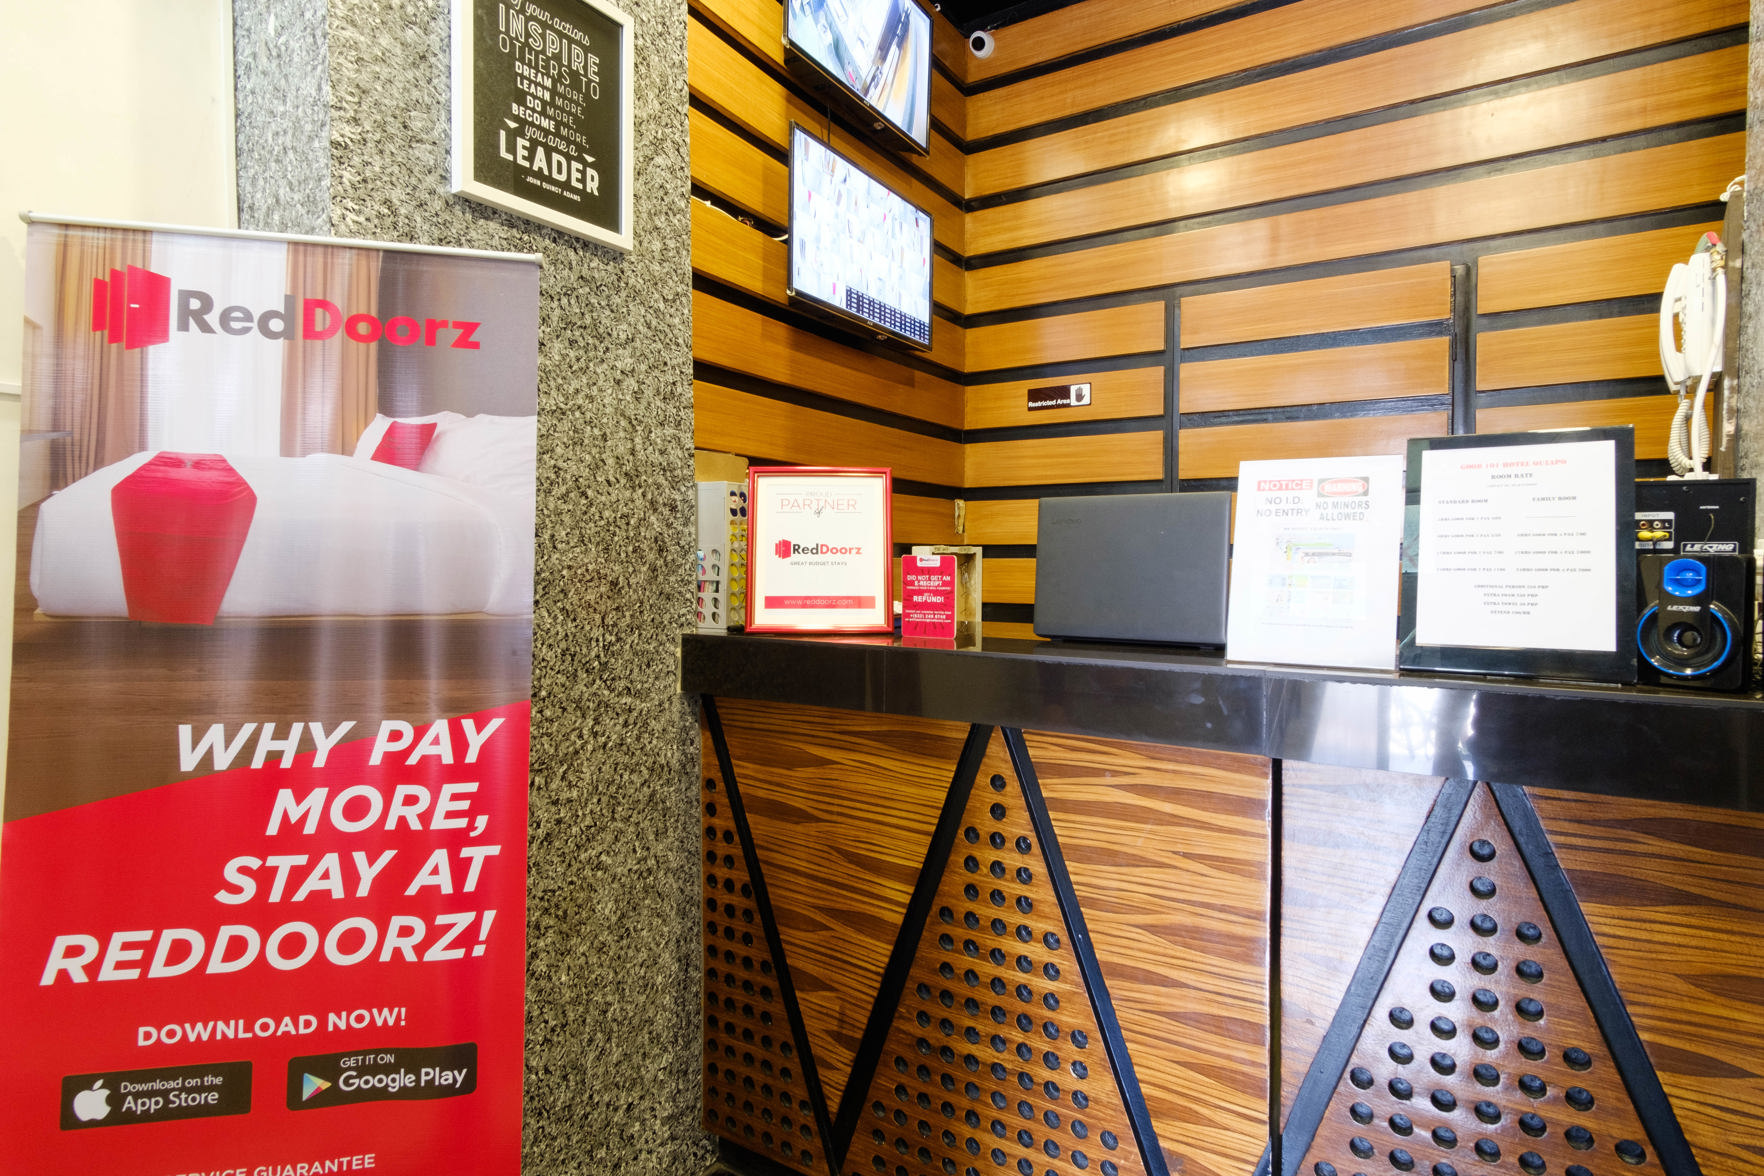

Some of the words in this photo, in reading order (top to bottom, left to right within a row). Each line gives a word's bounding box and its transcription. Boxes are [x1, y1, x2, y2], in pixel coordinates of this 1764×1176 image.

[525, 1, 552, 23] your
[554, 17, 591, 46] actions
[499, 3, 600, 82] INSPIRE
[499, 34, 570, 85] OTHERS
[580, 76, 600, 100] TO
[515, 61, 552, 89] DREAM
[557, 84, 586, 107] MORE,
[517, 76, 550, 102] LEARN
[556, 98, 585, 119] MORE,
[512, 102, 556, 133] BECOME
[561, 126, 589, 148] MORE,
[527, 96, 542, 111] DO
[547, 107, 576, 129] MORE,
[525, 125, 546, 143] you
[547, 135, 568, 152] are
[569, 143, 578, 157] a
[500, 129, 599, 196] LEADER
[526, 176, 541, 186] JOHN
[563, 190, 581, 202] ADAMS
[176, 288, 482, 350] RedDoorz
[1028, 400, 1056, 408] Restricted
[1260, 479, 1312, 490] NOTICE
[1265, 496, 1282, 505] NO
[780, 498, 857, 511] PARTNER
[1256, 508, 1272, 517] NO
[1274, 507, 1310, 517] ENTRY
[1315, 501, 1328, 511] NO
[1331, 500, 1370, 510] MINORS
[1319, 511, 1365, 521] ALLOWED
[792, 543, 862, 556] RedDoorz
[177, 720, 357, 772] WHY
[368, 718, 506, 766] PAY
[265, 782, 490, 837] MORE,
[213, 849, 398, 905] STAY
[404, 845, 502, 896] AT
[39, 909, 497, 986] REDDOORZ!
[137, 1014, 318, 1047] DOWNLOAD
[327, 1007, 407, 1032] NOW!
[340, 1056, 363, 1069] GET
[365, 1055, 377, 1066] IT
[378, 1053, 395, 1065] ON
[120, 1076, 183, 1094] Download
[184, 1077, 201, 1088] on
[203, 1073, 224, 1087] the
[338, 1068, 416, 1093] Google
[420, 1066, 468, 1089] Play
[121, 1094, 163, 1116] App
[168, 1089, 219, 1109] Store
[254, 1153, 376, 1176] GUARANTEE
